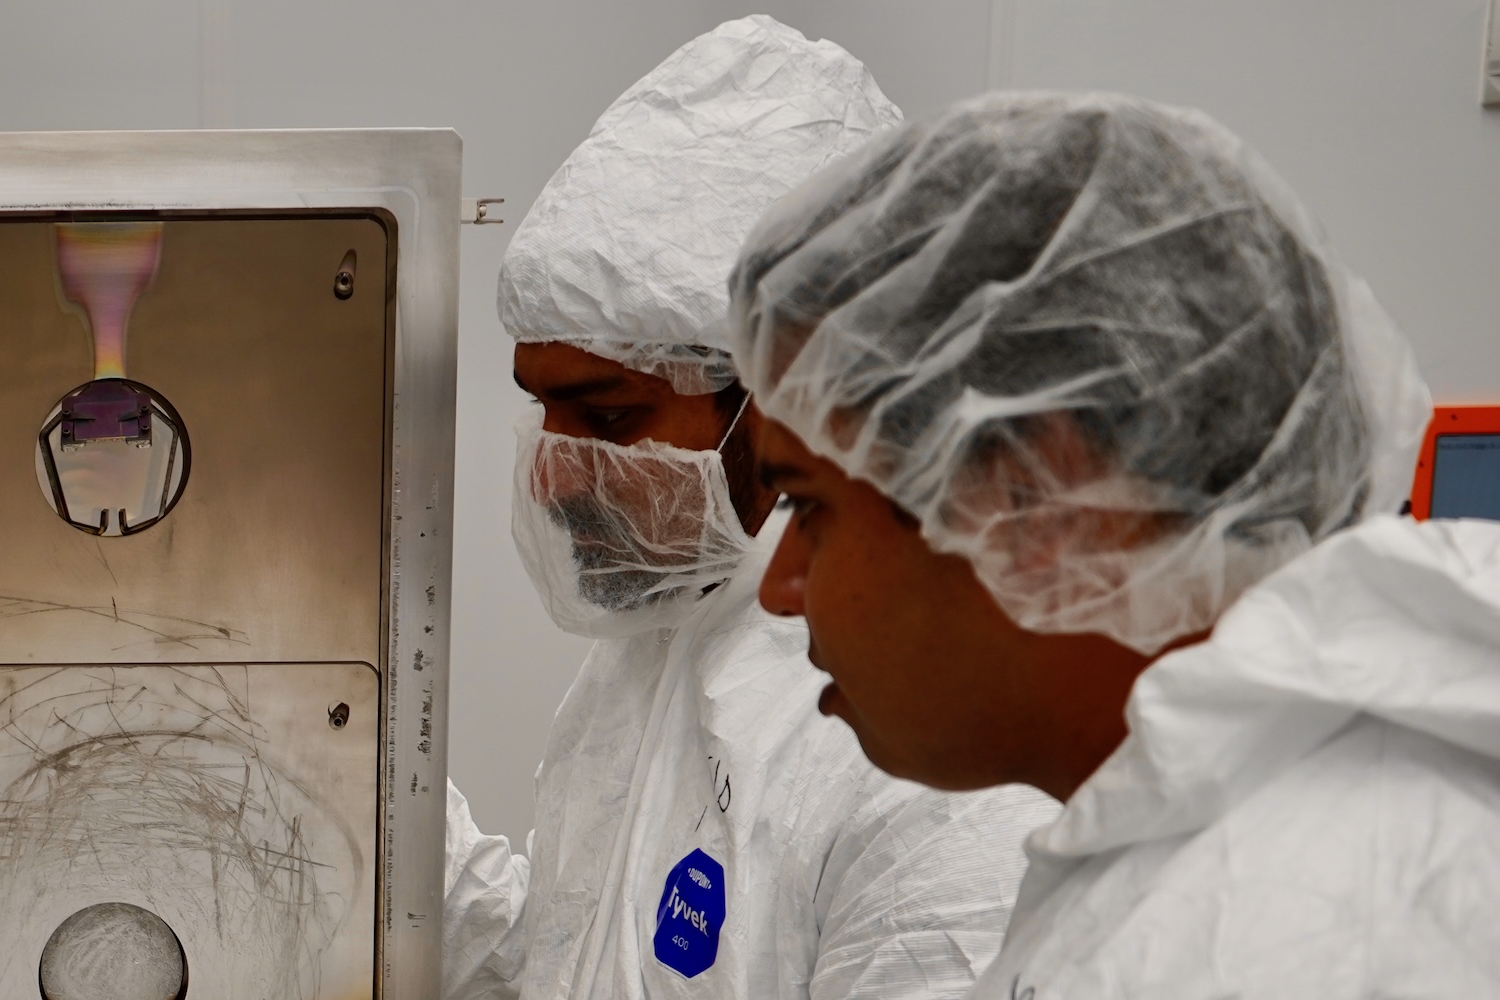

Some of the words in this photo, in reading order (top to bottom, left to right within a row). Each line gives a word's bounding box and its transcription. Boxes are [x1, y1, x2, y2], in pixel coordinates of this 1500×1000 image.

[688, 867, 712, 890] DUPONT
[668, 885, 709, 938] Tyvek
[671, 934, 689, 951] 400
